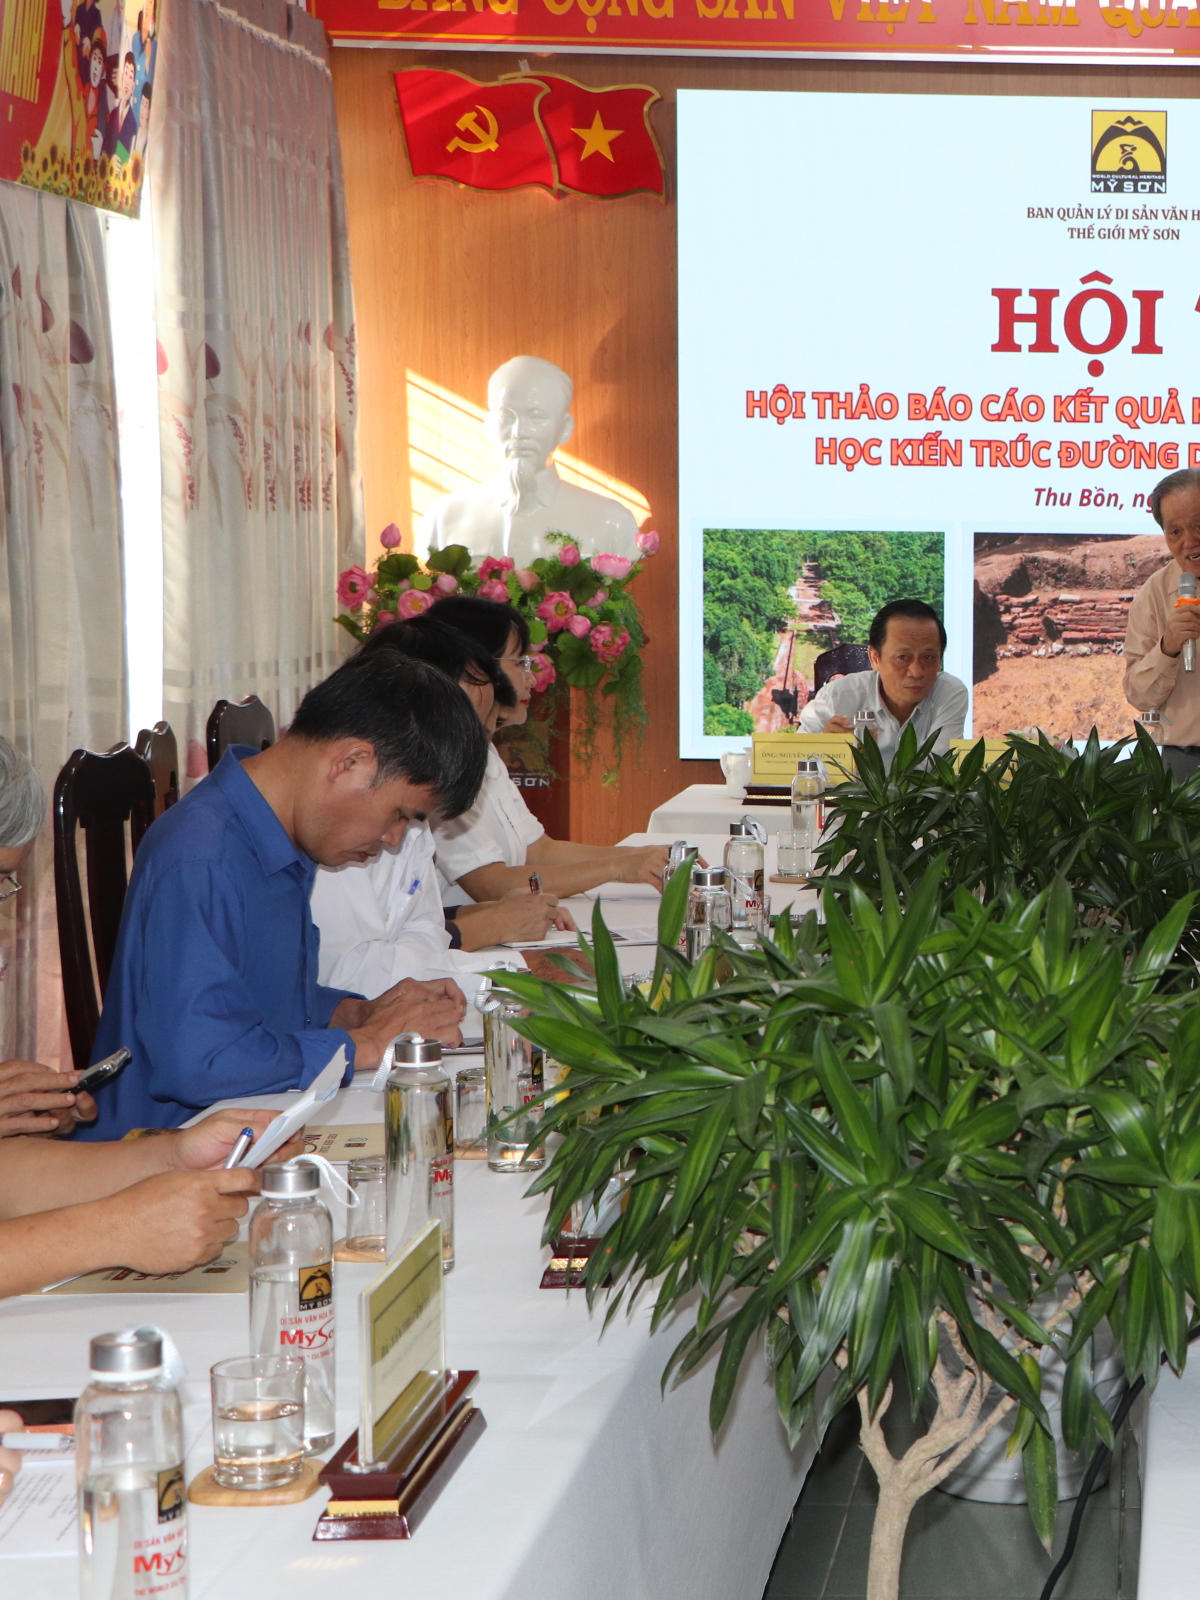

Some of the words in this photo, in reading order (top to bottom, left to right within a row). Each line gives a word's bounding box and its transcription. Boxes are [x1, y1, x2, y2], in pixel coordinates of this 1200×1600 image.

[1091, 179, 1118, 192] MỸ
[1123, 181, 1166, 193] SƠN
[1027, 207, 1054, 219] BAN
[1057, 204, 1094, 221] QUẢN
[1097, 205, 1113, 220] LÝ
[1115, 208, 1129, 220] DI
[1131, 205, 1159, 221] SẢN
[1161, 206, 1189, 221] VĂN
[1068, 224, 1095, 239] THẾ
[1097, 226, 1126, 240] GIỚI
[1128, 226, 1150, 240] MỸ
[1152, 227, 1180, 241] SƠN
[991, 270, 1164, 377] HỘI
[746, 384, 806, 424] HỘI
[812, 384, 898, 420] THẢO
[908, 387, 972, 422] BÁO
[980, 388, 1045, 422] CÁO
[1053, 387, 1109, 423] KẾT
[1115, 388, 1185, 429] QUẢ
[815, 437, 882, 471] HỌC
[890, 431, 963, 467] KIẾN
[970, 434, 1051, 468] TRÚC
[1058, 435, 1179, 470] ĐƯỜNG
[1034, 488, 1071, 507] Thu
[1079, 486, 1124, 510] Bồn,
